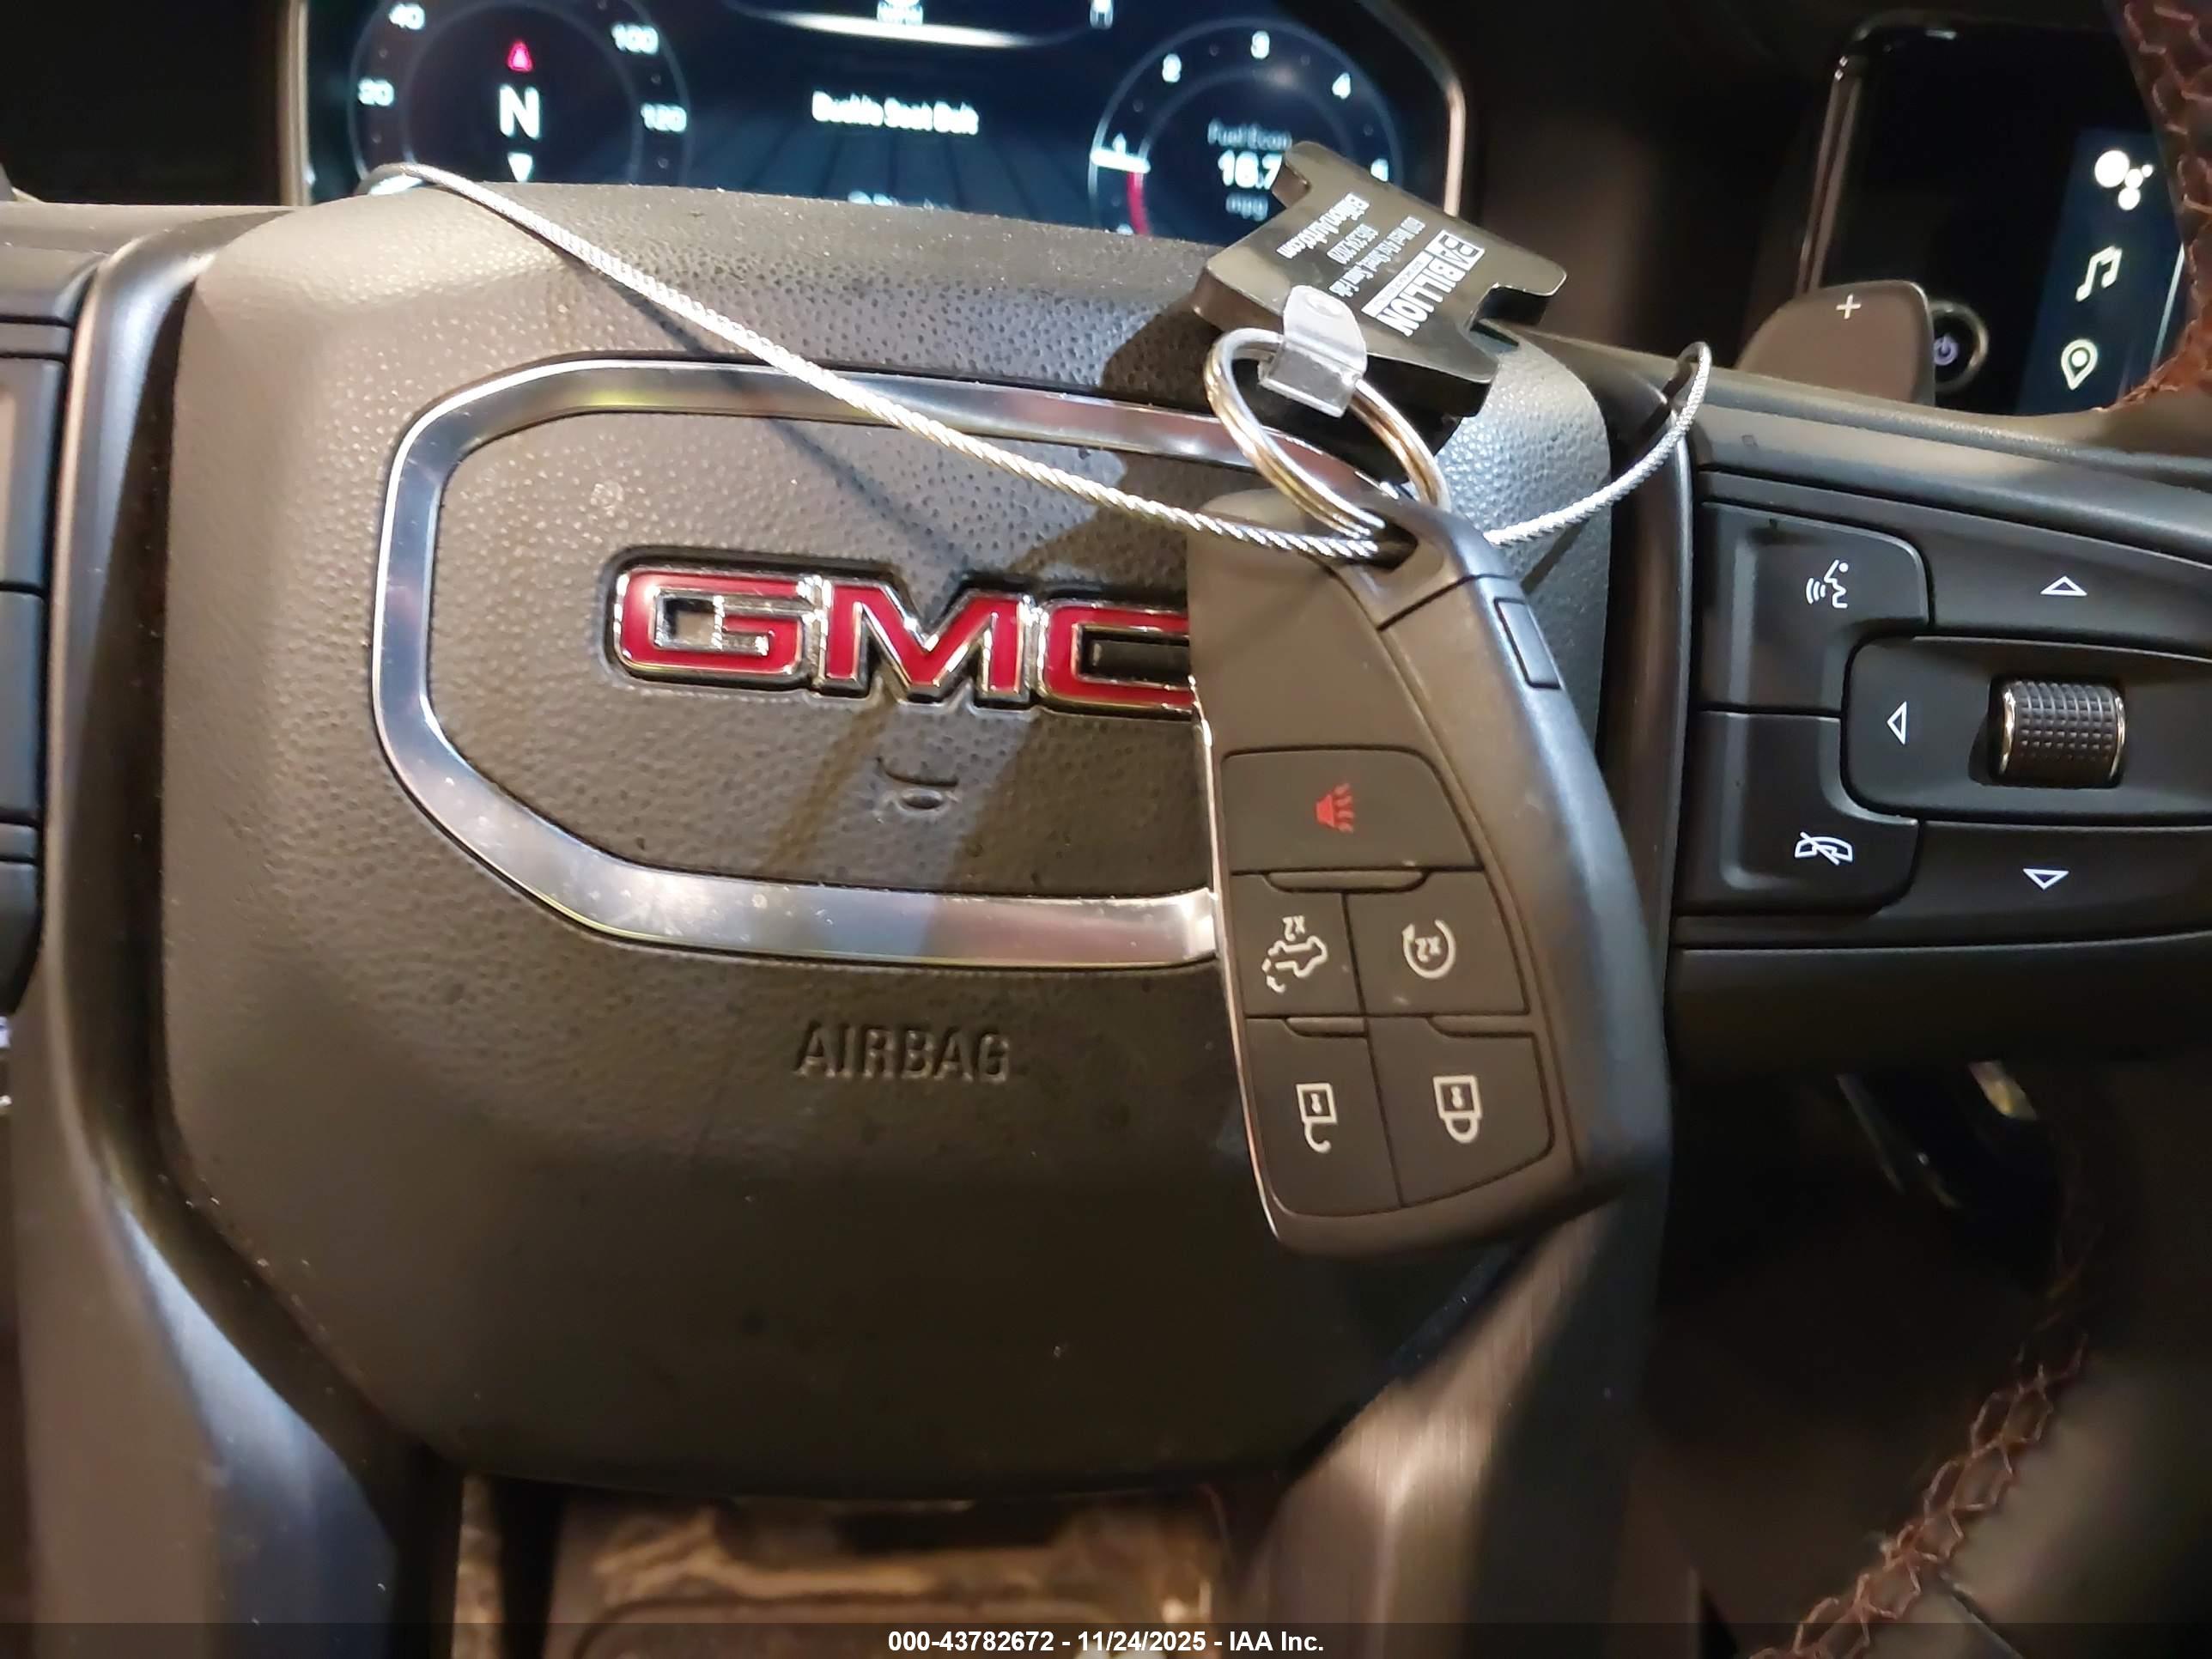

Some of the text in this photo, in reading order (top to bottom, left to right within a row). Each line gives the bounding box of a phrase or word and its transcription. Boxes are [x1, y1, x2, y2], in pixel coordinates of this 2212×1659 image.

[498, 83, 541, 139] N
[1376, 258, 1467, 337] BILLION
[613, 567, 1195, 713] GMC
[792, 1023, 1010, 1083] AIRBAG
